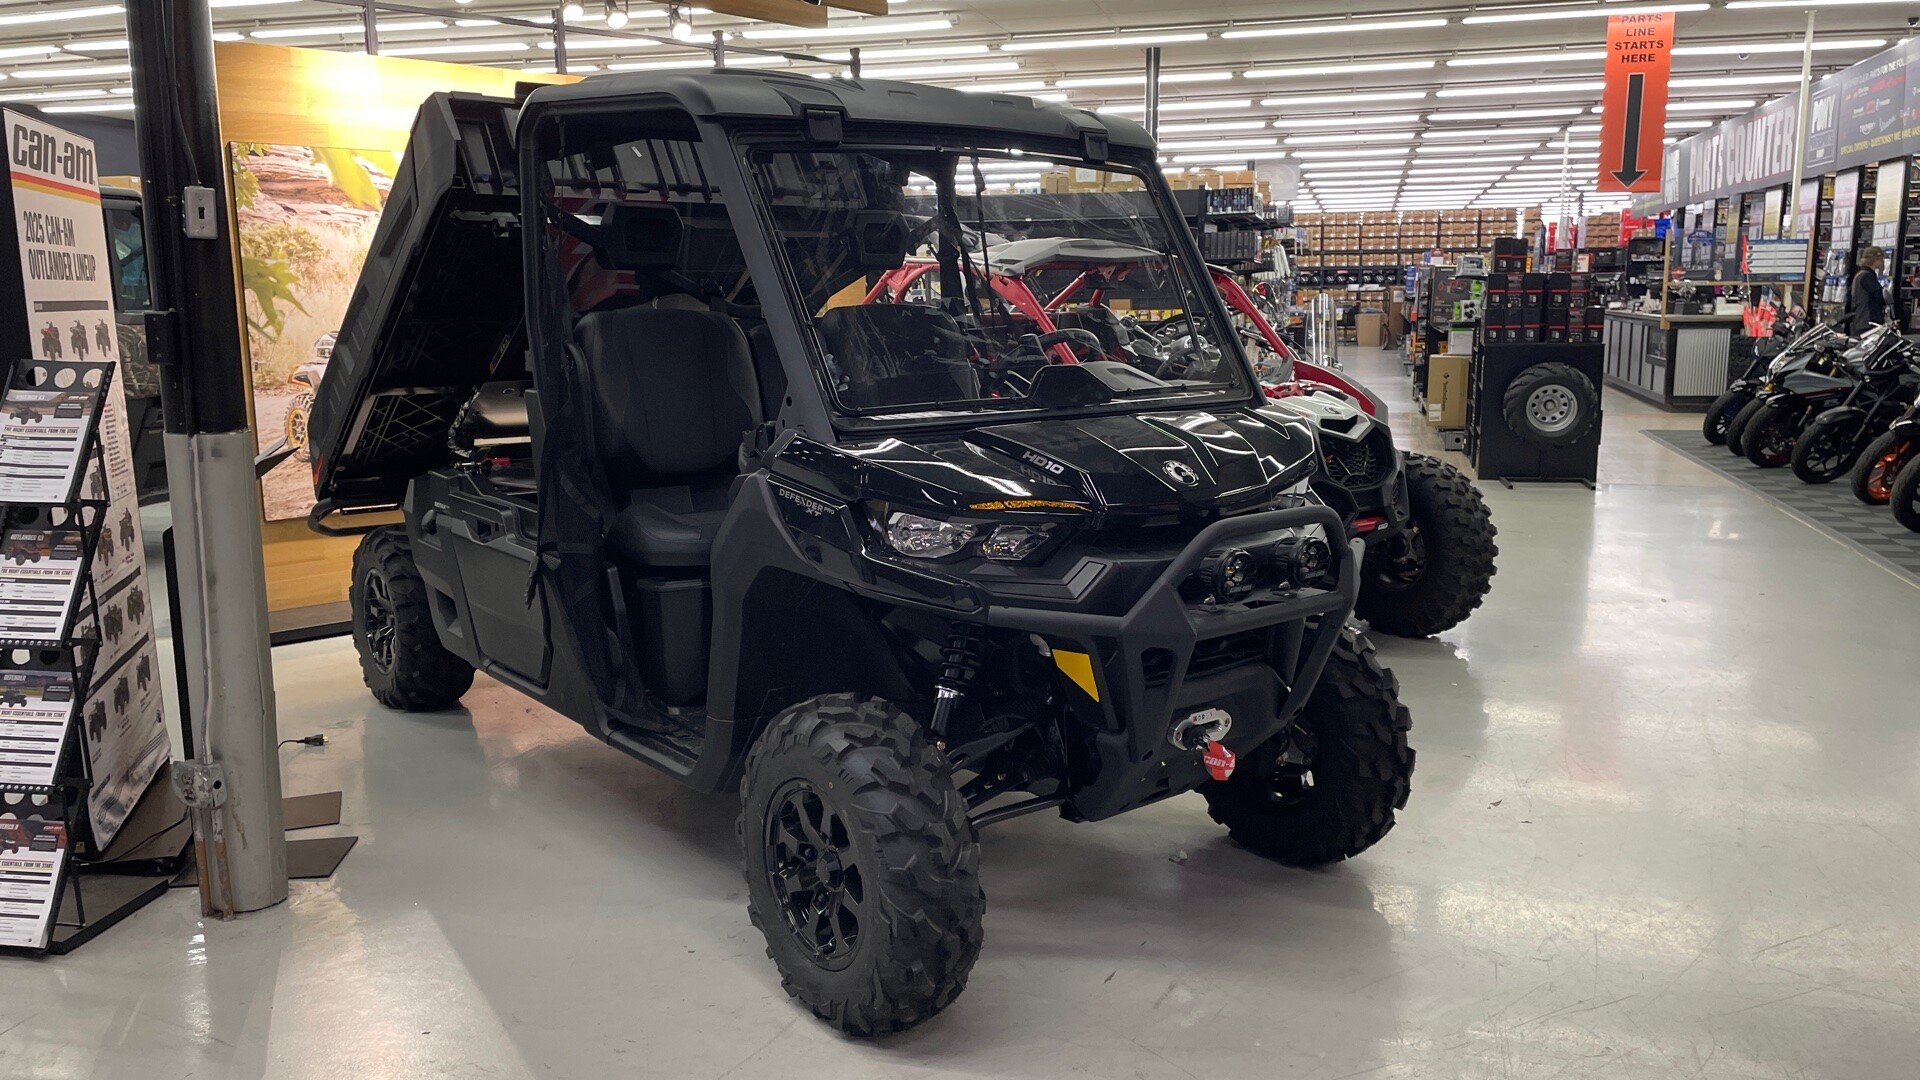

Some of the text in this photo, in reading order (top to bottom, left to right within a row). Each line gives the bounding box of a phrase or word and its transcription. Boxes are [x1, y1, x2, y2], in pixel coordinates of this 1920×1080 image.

[1621, 14, 1662, 23] PARTS
[1626, 27, 1655, 37] LINE
[1614, 40, 1664, 50] STARTS
[1621, 53, 1656, 63] HERE
[13, 123, 94, 185] can-am
[1689, 134, 1724, 197] PARTS
[1726, 106, 1796, 186] COUNTER
[24, 211, 76, 248] 2025 CAN-AM
[28, 248, 96, 282] OUTLANDER LINEUP
[1022, 451, 1065, 475] HD10
[779, 488, 824, 513] DEFENDER
[806, 508, 822, 517] XT
